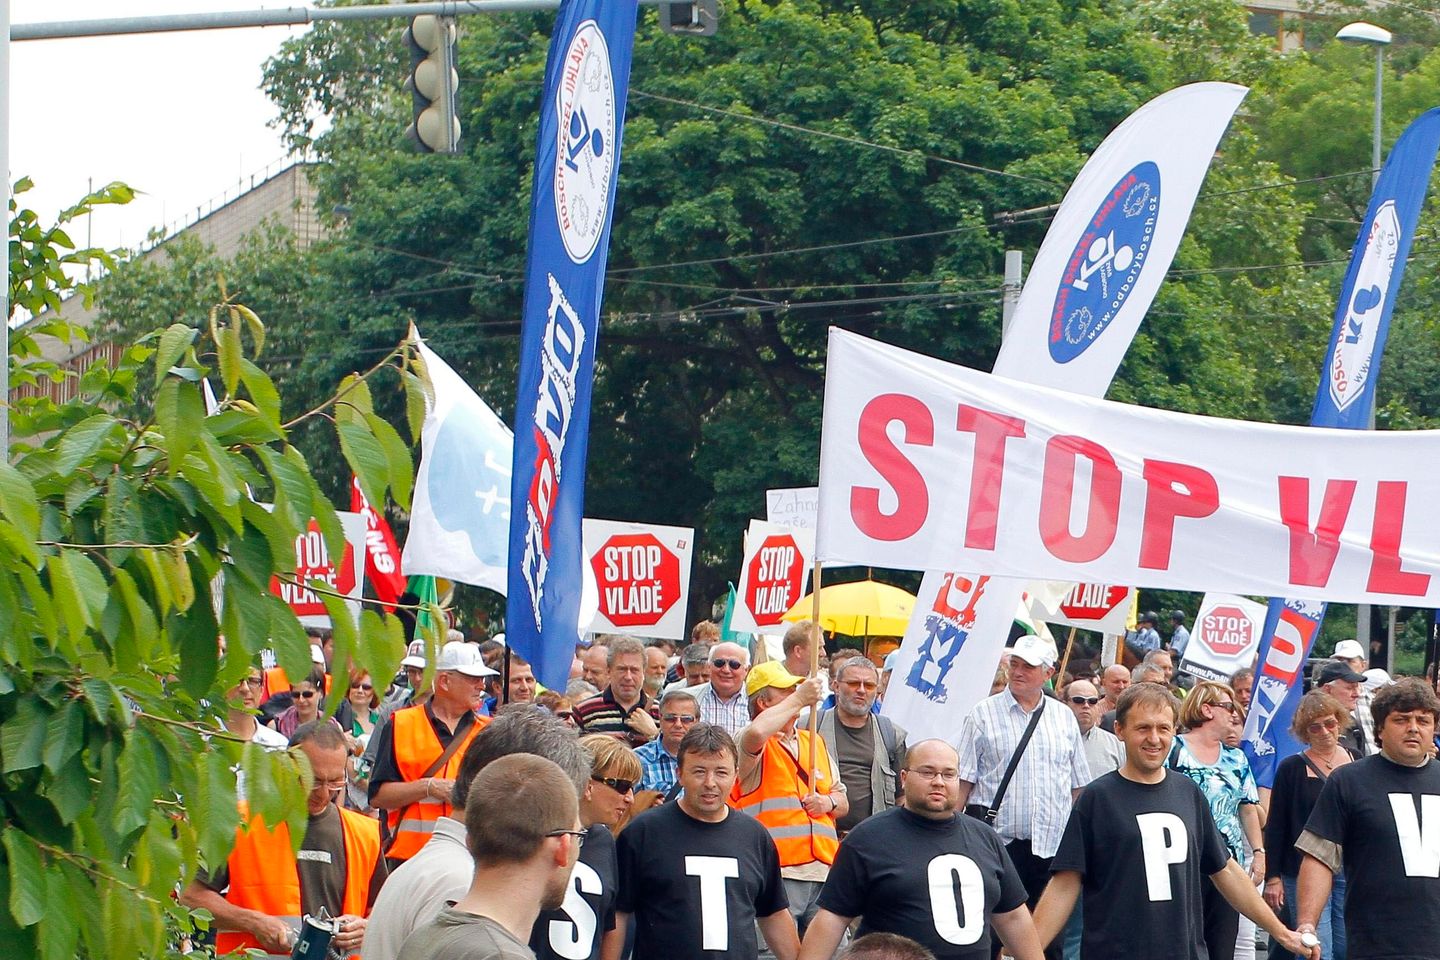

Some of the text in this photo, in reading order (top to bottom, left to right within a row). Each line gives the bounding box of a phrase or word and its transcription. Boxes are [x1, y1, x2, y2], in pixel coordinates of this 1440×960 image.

[556, 36, 590, 232] BOSCH DIESEL JIHLAVA
[1087, 195, 1158, 341] www.odborybosch.cz
[849, 392, 1221, 571] STOP
[604, 545, 662, 582] STOP
[758, 546, 795, 583] STOP
[604, 580, 663, 615] VLÁDĚ
[754, 580, 792, 615] VLÁDĚ
[1204, 615, 1251, 633] STOP
[1206, 629, 1249, 647] VLÁDĚ
[1135, 812, 1189, 902] P
[684, 855, 740, 952] T
[926, 852, 987, 946] O
